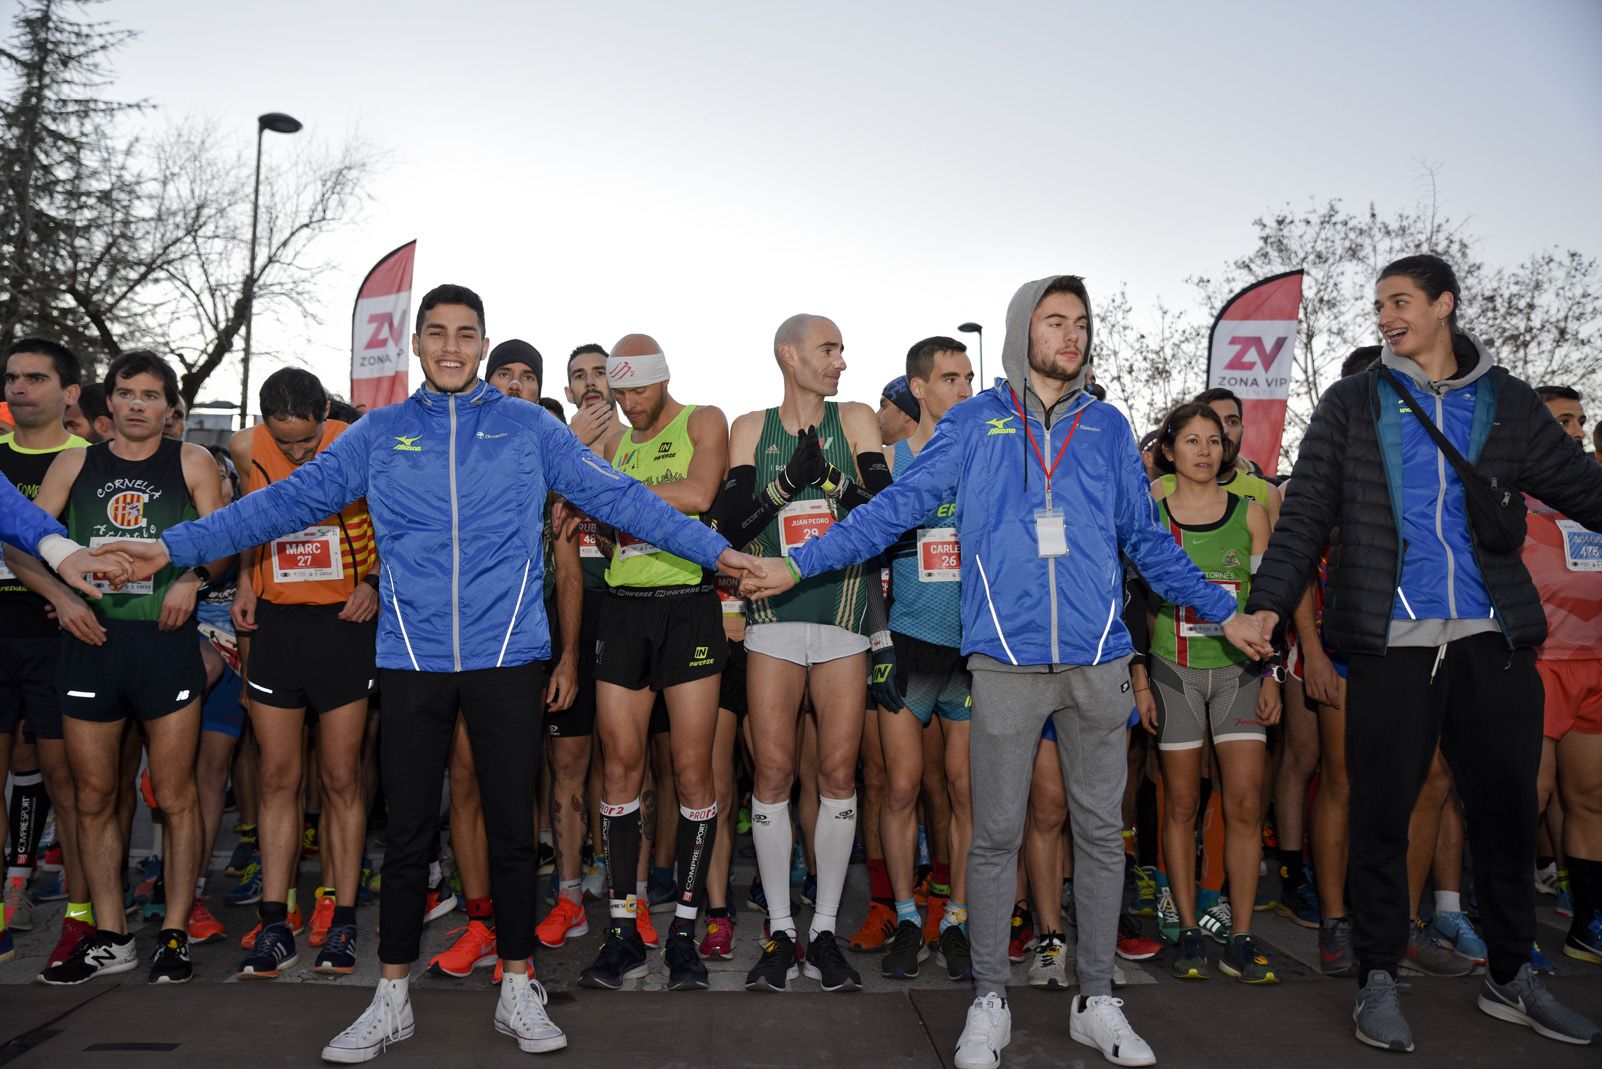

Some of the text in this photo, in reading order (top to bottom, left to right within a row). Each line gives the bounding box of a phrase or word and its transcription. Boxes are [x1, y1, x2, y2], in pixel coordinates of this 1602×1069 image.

[360, 353, 393, 367] ZONA
[1222, 336, 1288, 374] ZV
[1217, 377, 1288, 387] ZONA VIP
[791, 517, 829, 527] JUAN PEDRO
[803, 528, 819, 540] 29
[286, 543, 321, 555] MARC
[297, 555, 312, 567] 27
[942, 555, 957, 567] 26
[667, 586, 699, 596] INVERSE
[689, 658, 715, 667] INVERSE
